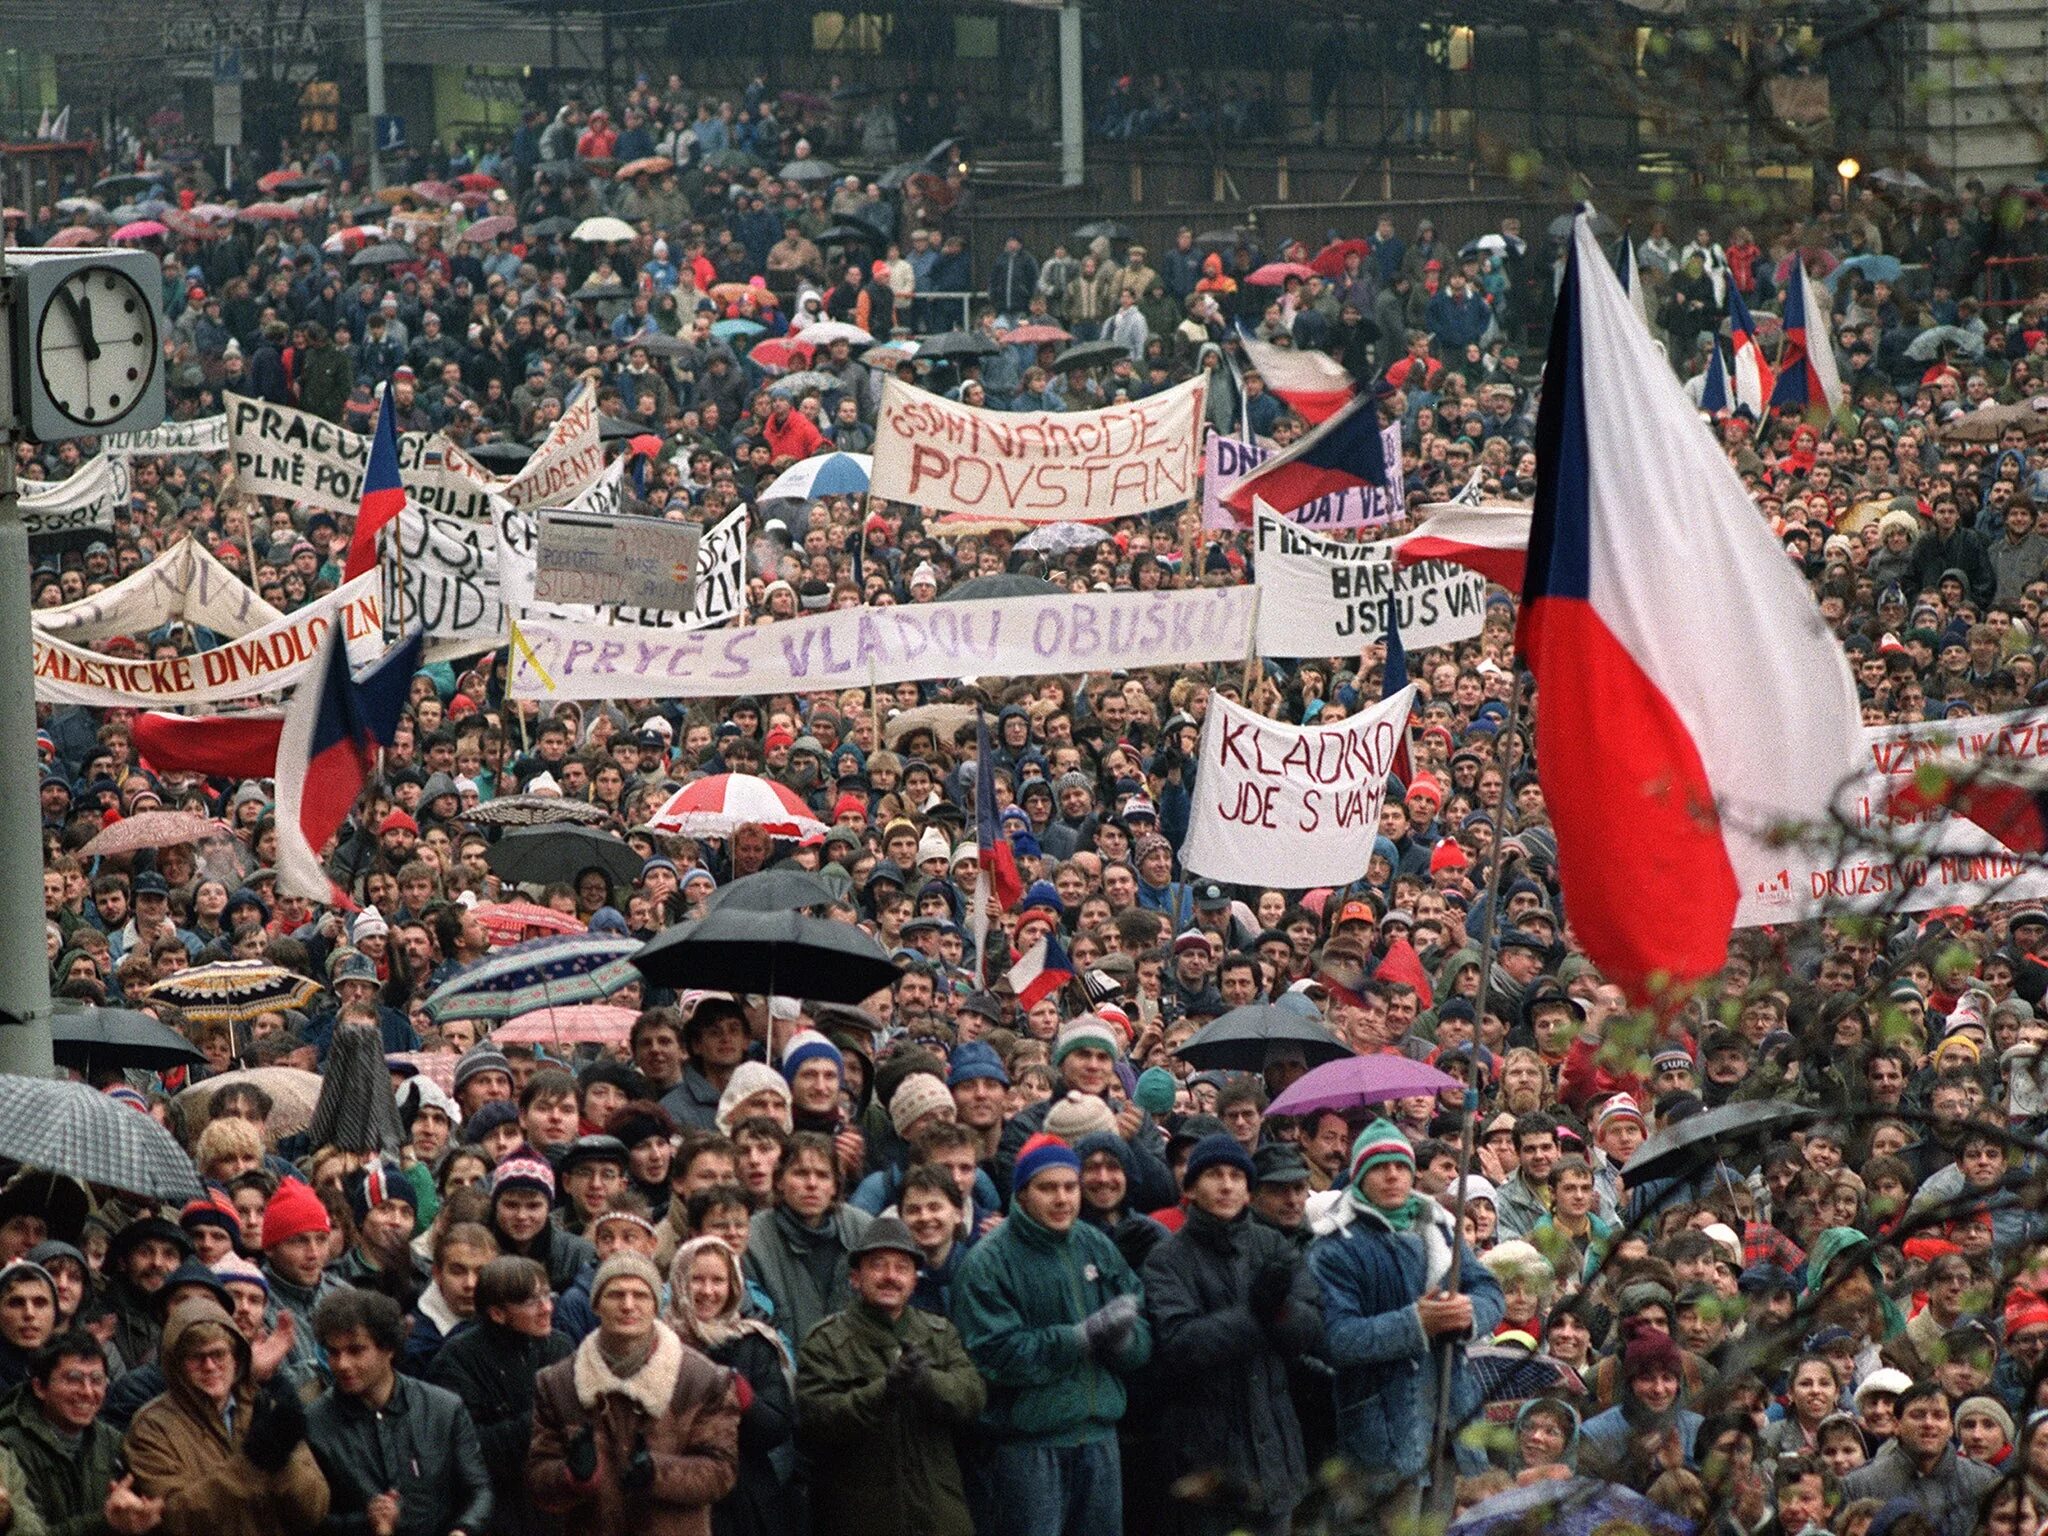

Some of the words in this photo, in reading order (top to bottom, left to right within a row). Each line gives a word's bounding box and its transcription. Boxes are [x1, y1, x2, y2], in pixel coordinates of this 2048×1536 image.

[236, 452, 306, 486] PLNĚ
[1419, 587, 1439, 627] S
[563, 633, 706, 677] PRYČ
[711, 629, 757, 680] S
[1220, 713, 1395, 785] KLADNO
[1218, 780, 1282, 830] JDE
[1299, 788, 1322, 833] S
